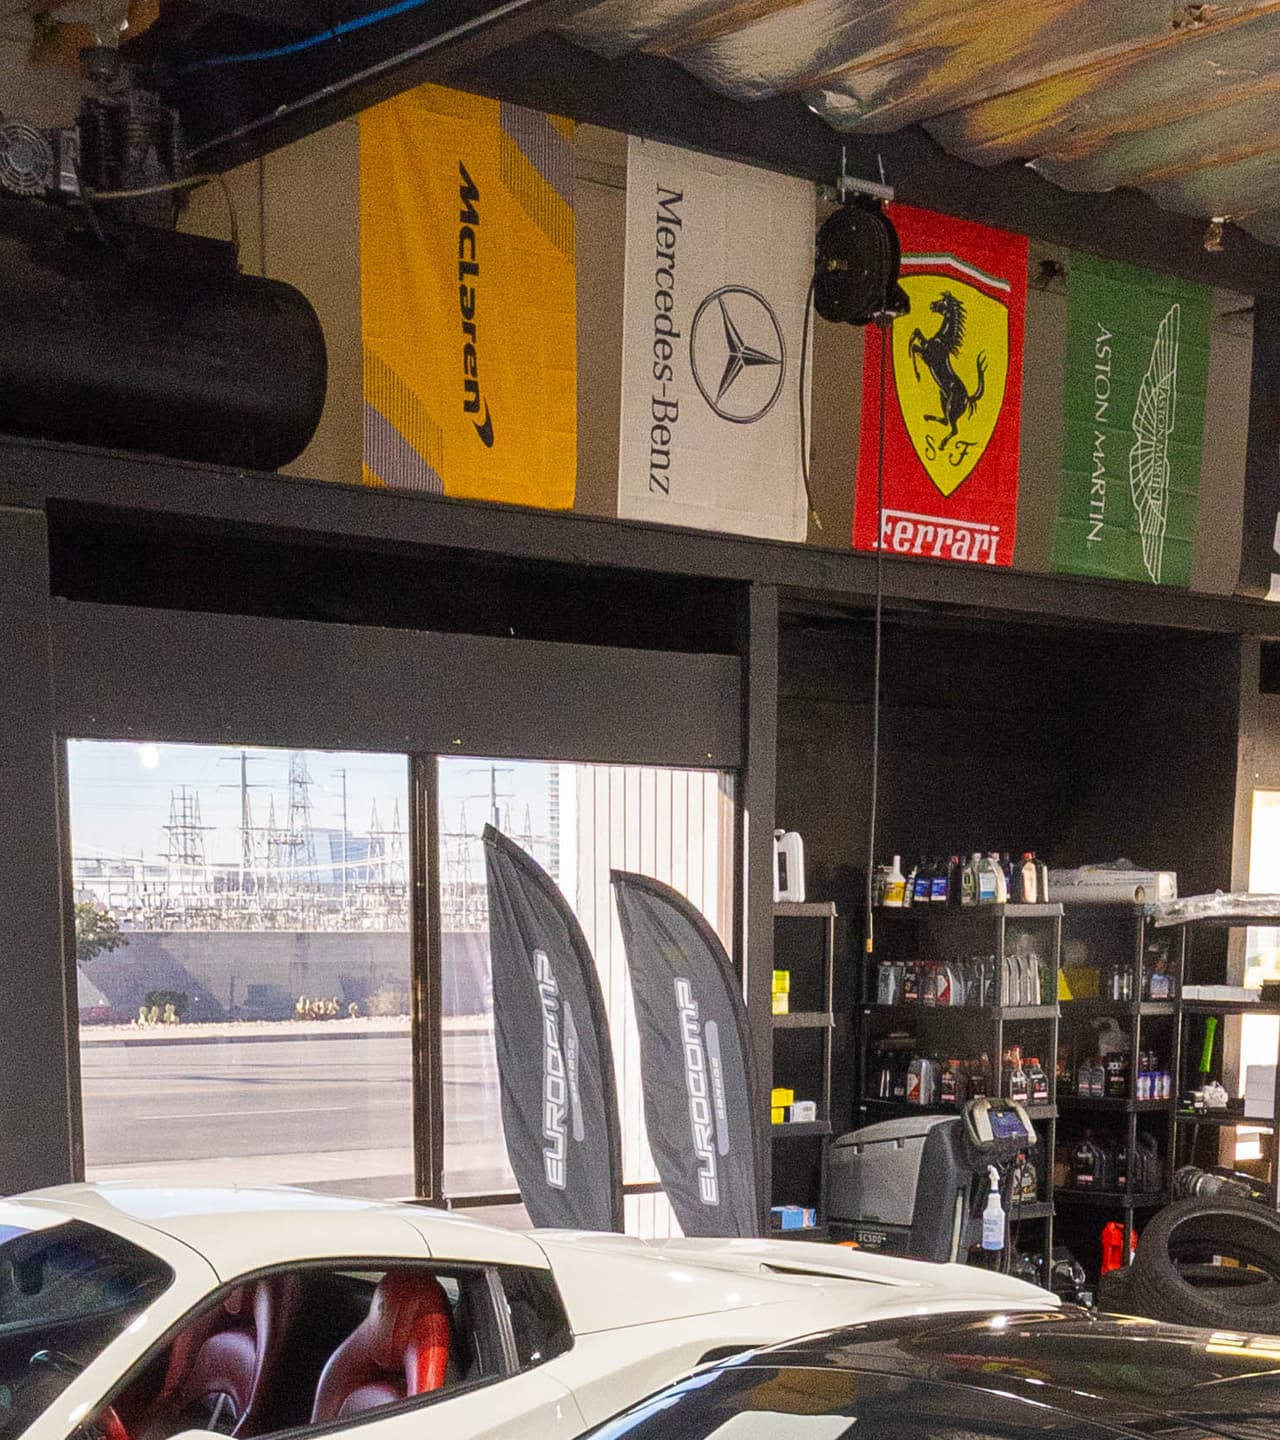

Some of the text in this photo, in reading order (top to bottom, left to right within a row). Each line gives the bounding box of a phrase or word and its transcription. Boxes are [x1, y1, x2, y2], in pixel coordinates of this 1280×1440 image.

[457, 160, 482, 415] McLaren
[649, 183, 684, 496] Mercedes-Benz
[872, 508, 1000, 565] Ferrari
[925, 434, 936, 461] S
[1086, 321, 1113, 542] ASTON MARTIN
[1152, 386, 1170, 500] ASTON MARTIN
[675, 978, 718, 1205] EUROCOMP
